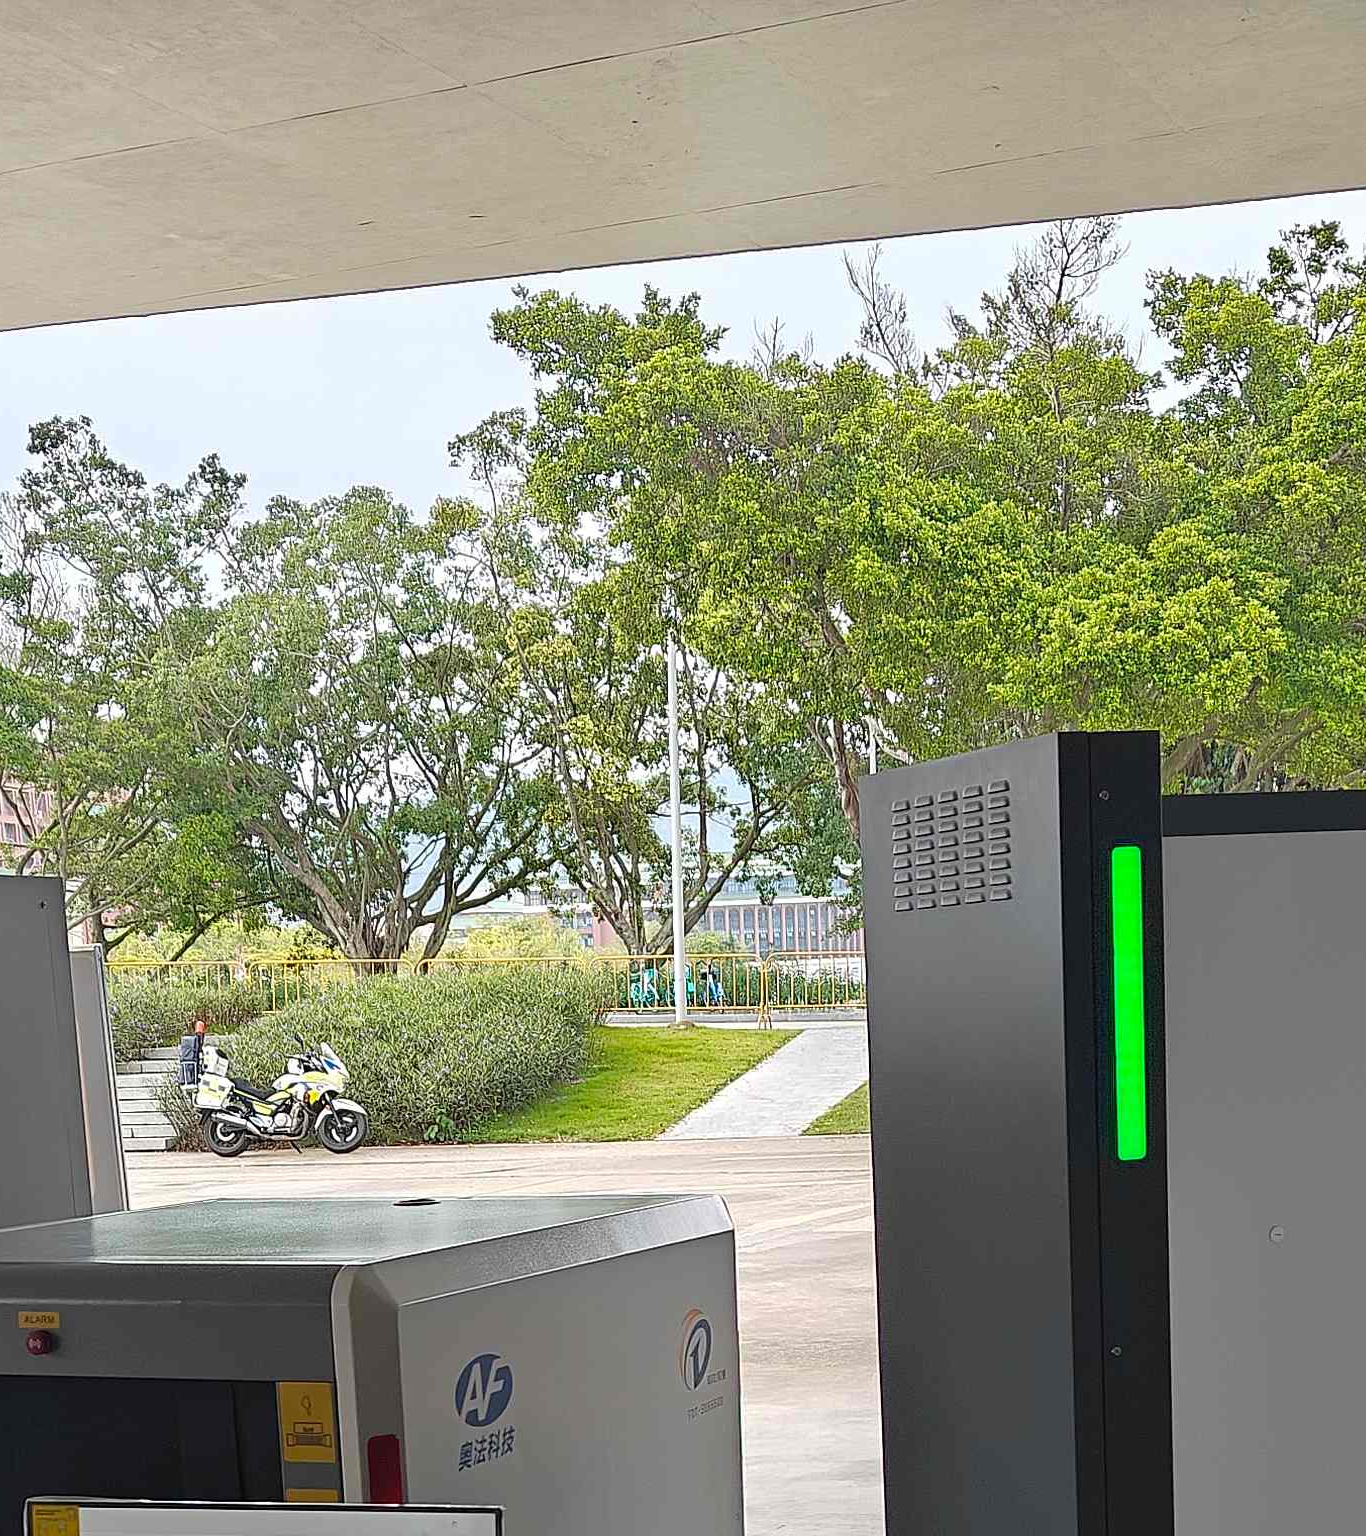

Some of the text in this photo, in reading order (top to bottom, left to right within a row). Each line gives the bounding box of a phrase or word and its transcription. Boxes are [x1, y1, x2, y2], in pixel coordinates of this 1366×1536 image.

[23, 1315, 55, 1324] ALARM
[458, 1425, 516, 1472] 奥法科技
